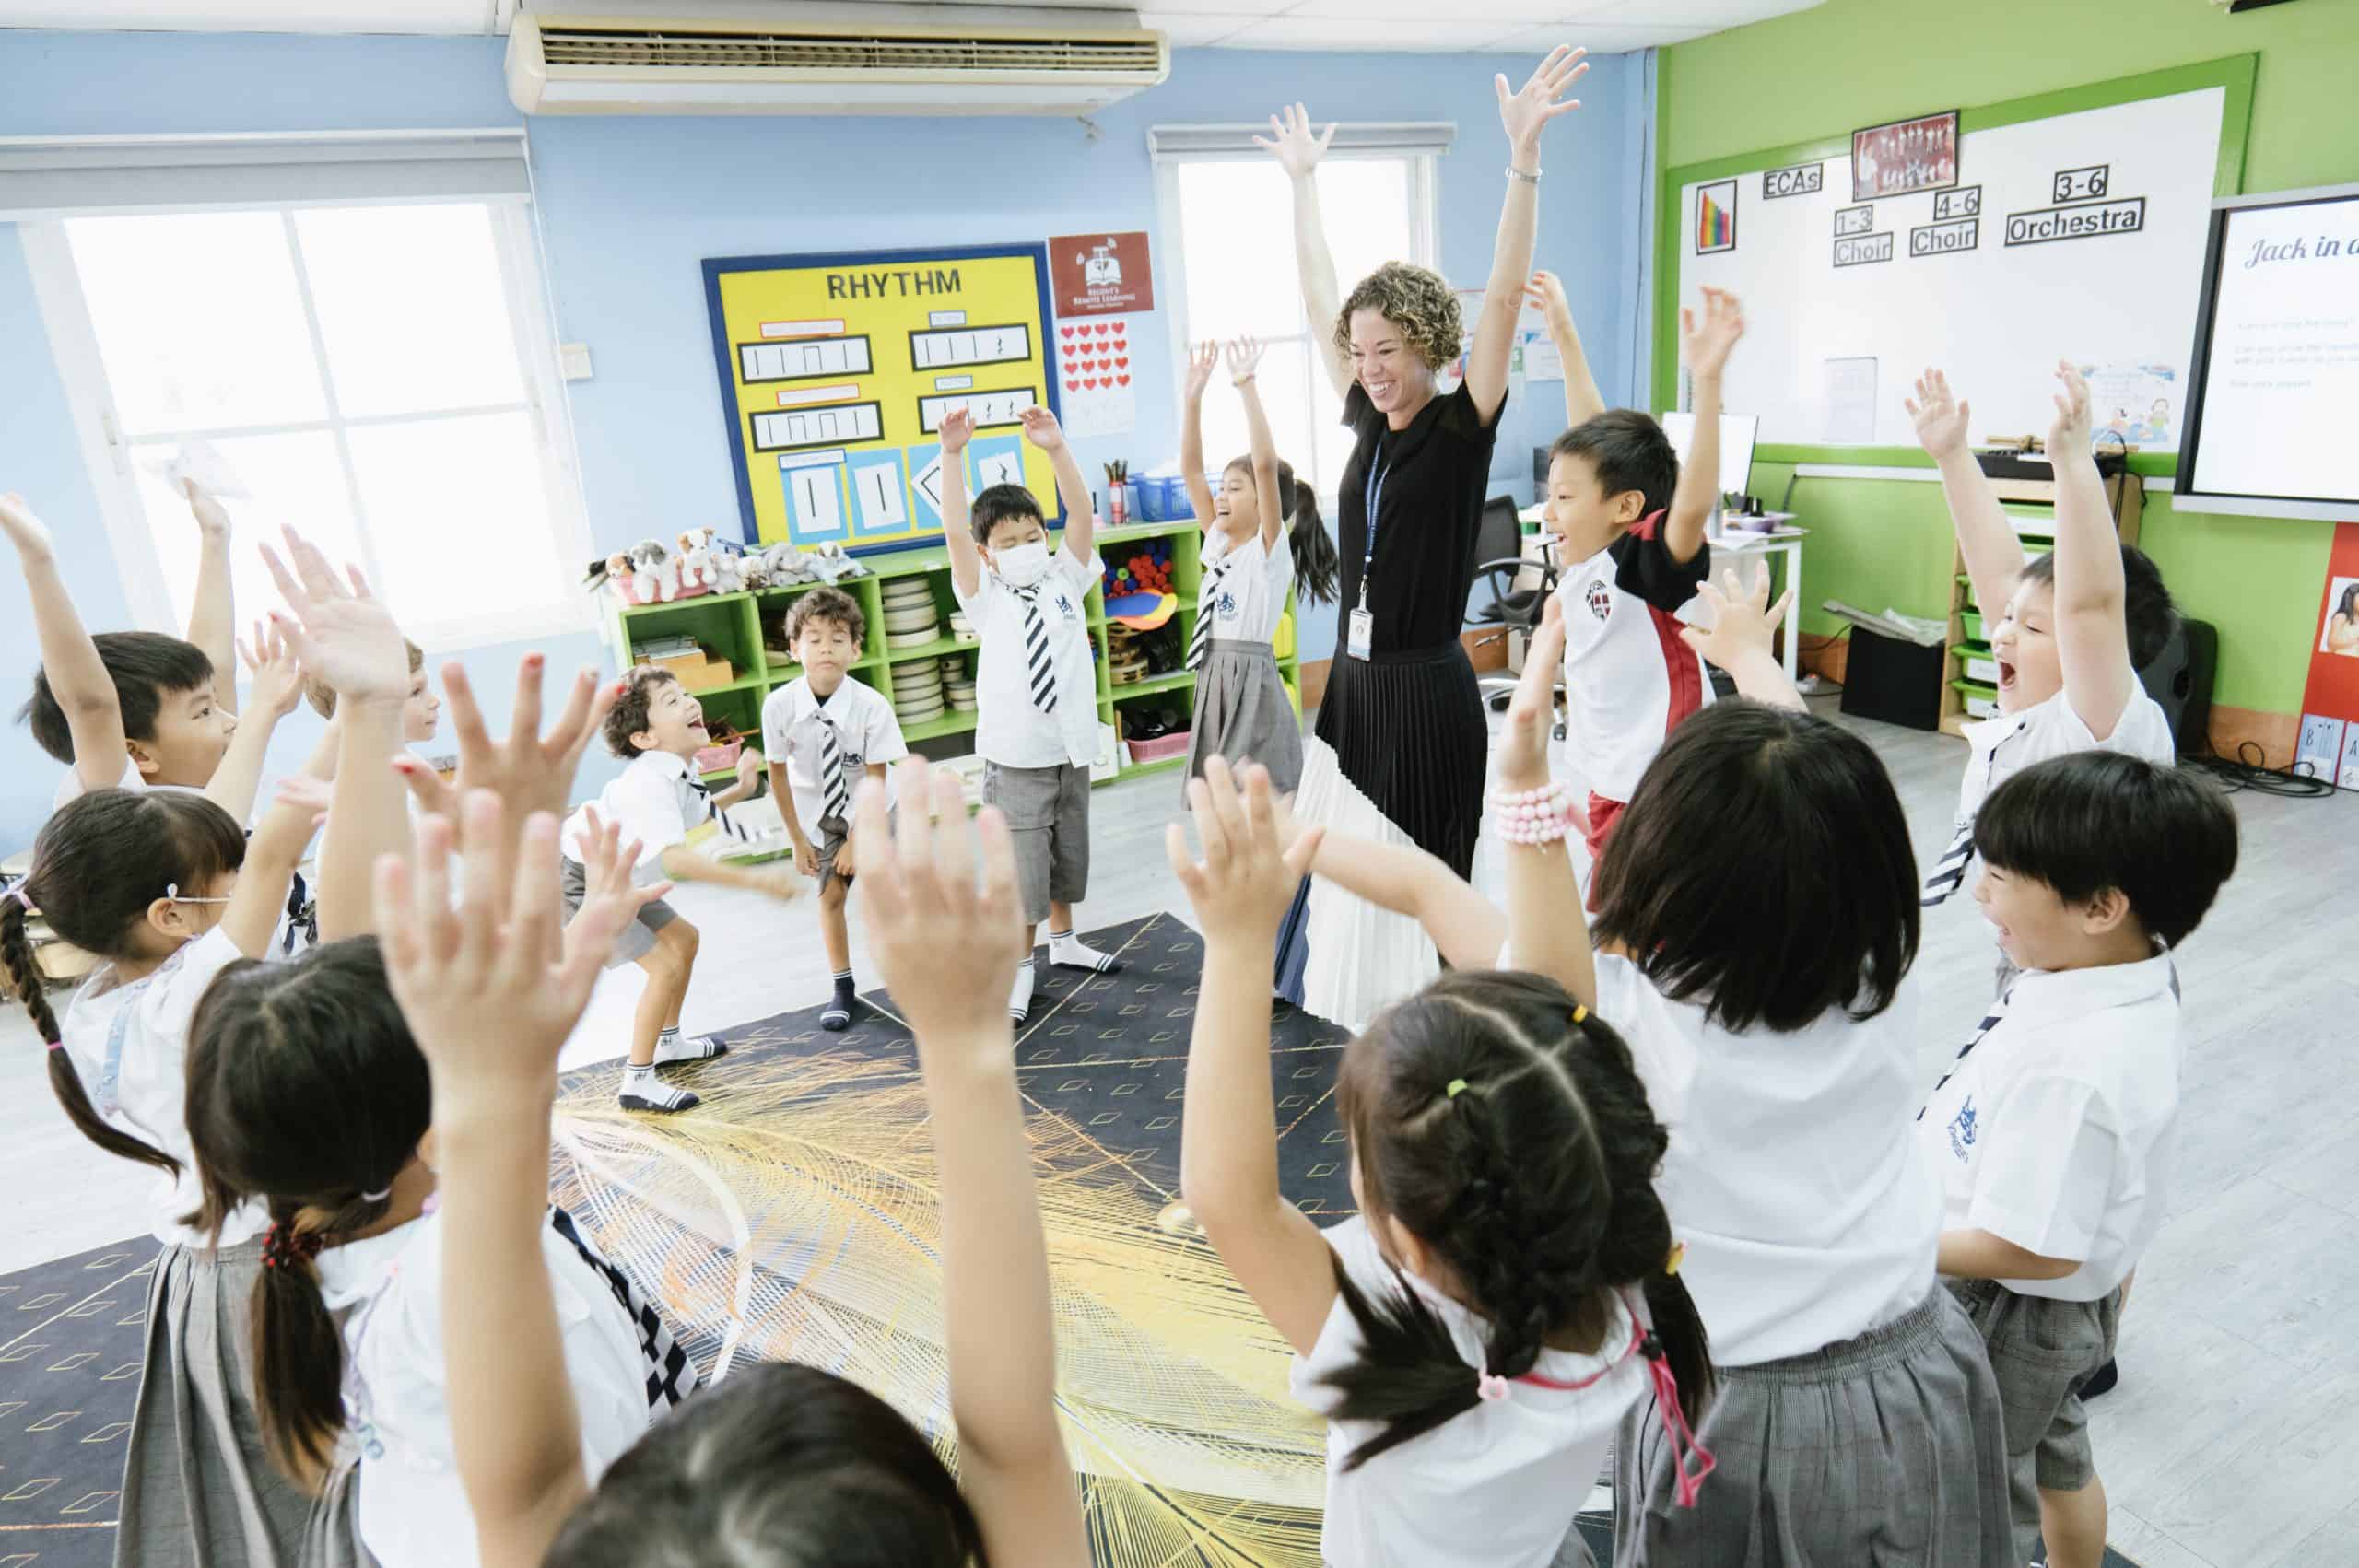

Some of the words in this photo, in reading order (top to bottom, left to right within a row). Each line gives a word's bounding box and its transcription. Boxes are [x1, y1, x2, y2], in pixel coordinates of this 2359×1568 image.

[1765, 170, 1818, 195] ECAs
[2057, 170, 2105, 200] 3-6
[1938, 191, 1978, 216] 4-6
[1837, 209, 1872, 232] 1-3
[2010, 208, 2138, 240] Orchestra
[1837, 239, 1891, 263] Choir
[1913, 225, 1974, 252] Choir
[2244, 237, 2307, 269] Jack
[2314, 235, 2341, 258] in
[826, 268, 962, 299] RHYTHM
